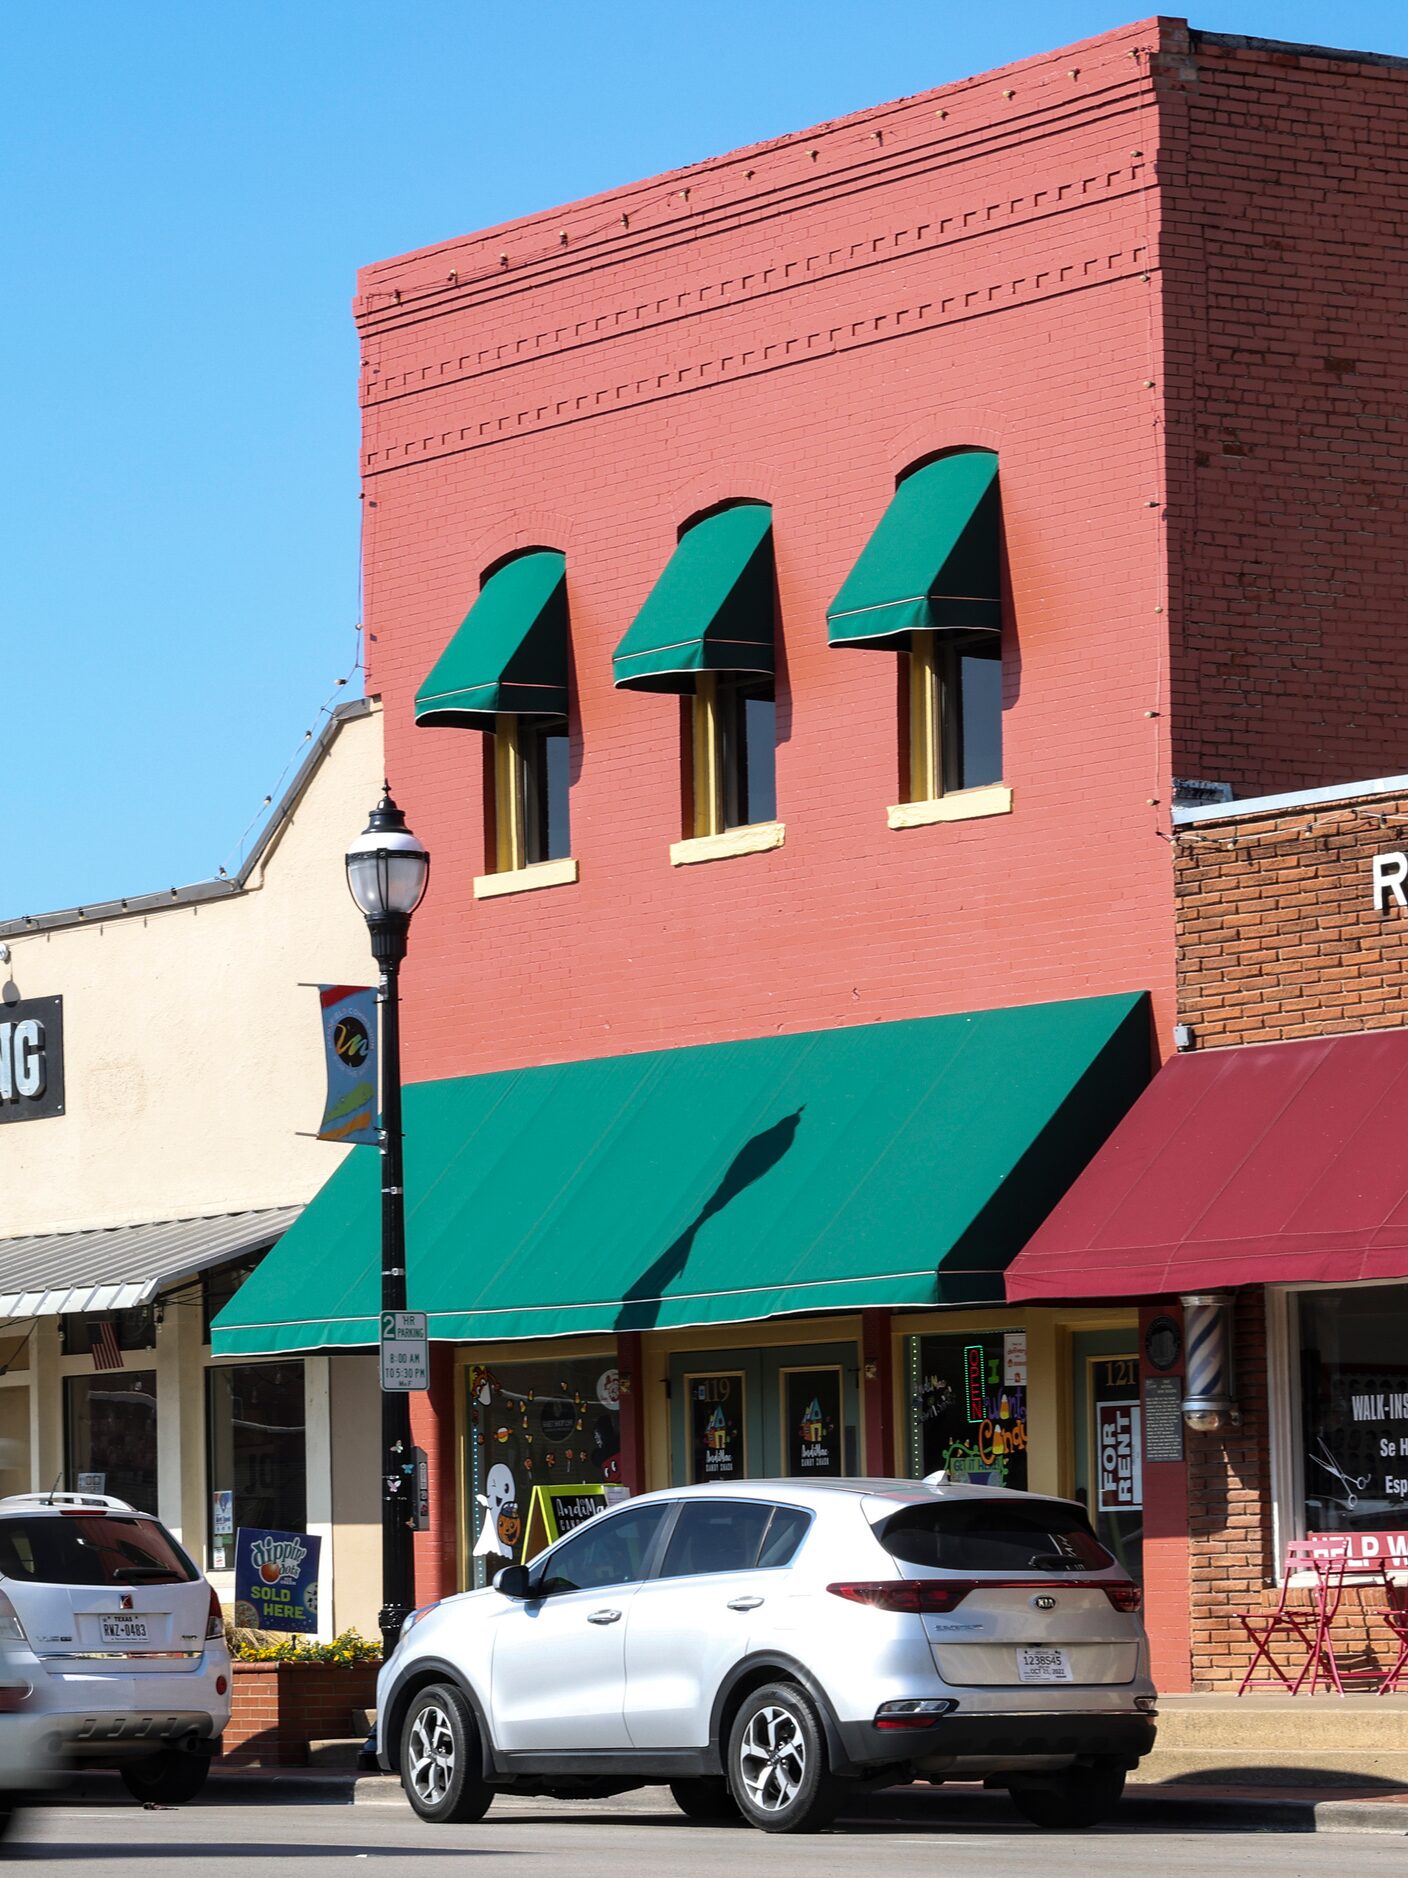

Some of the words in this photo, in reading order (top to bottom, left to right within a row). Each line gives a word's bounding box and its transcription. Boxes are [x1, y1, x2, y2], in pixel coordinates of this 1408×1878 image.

[383, 1315, 395, 1338] 2
[402, 1315, 415, 1325] HR
[397, 1328, 424, 1338] PARKING
[390, 1353, 407, 1363] 8:00
[410, 1353, 420, 1363] AM
[385, 1368, 394, 1378] TO
[396, 1368, 413, 1378] 5:30
[415, 1368, 425, 1378] PM
[1105, 1361, 1136, 1386] 121
[704, 1379, 730, 1401] 119
[968, 1350, 983, 1419] OPEN
[1103, 1423, 1117, 1491] FOR
[1116, 1410, 1132, 1501] RENT
[1380, 1438, 1396, 1457] Se
[556, 1498, 607, 1517] AndiMa
[280, 1562, 300, 1578] dots
[251, 1586, 290, 1602] SOLD
[1038, 1599, 1054, 1607] KIA
[263, 1603, 305, 1619] HERE
